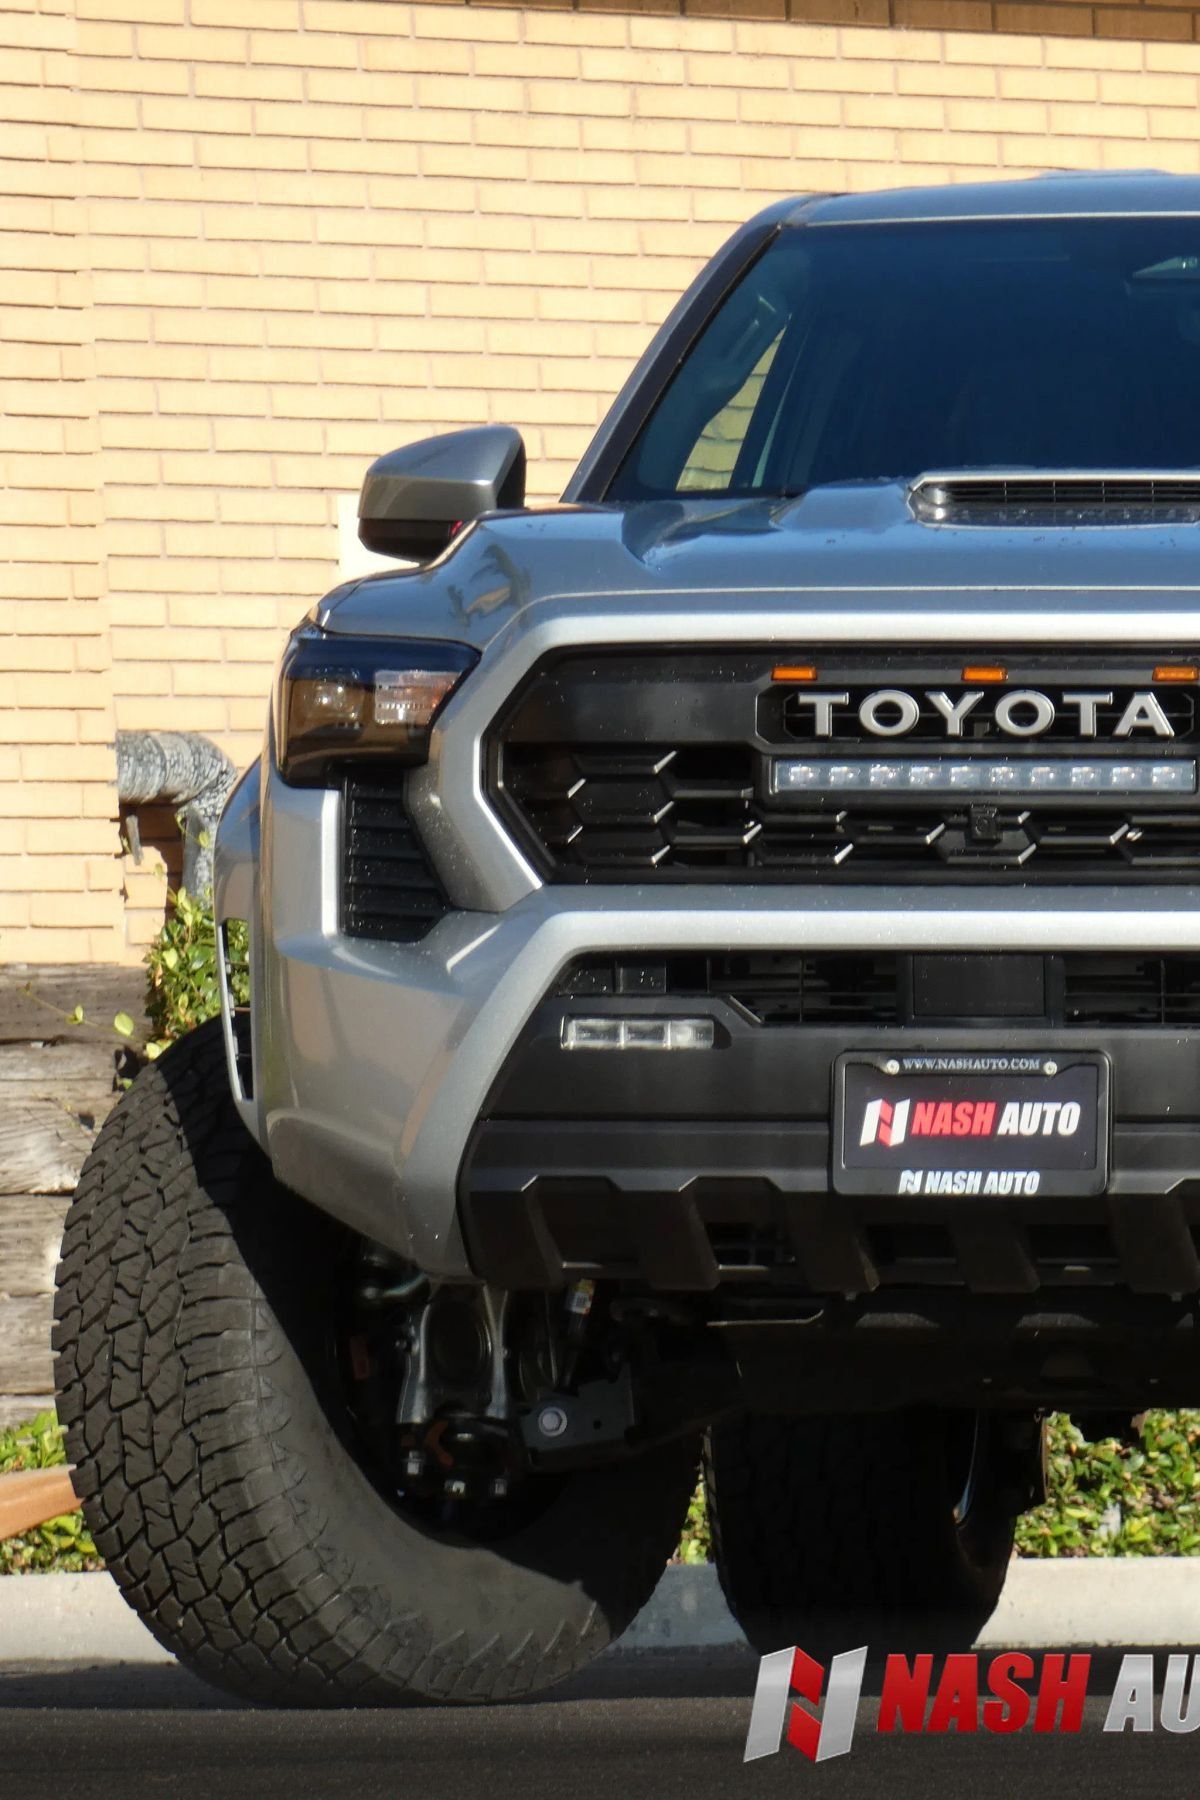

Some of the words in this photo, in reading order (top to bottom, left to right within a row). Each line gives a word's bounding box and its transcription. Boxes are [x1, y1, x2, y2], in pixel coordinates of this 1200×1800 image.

[798, 690, 1174, 737] TOYOTA
[902, 1058, 1040, 1071] WWW.NASHAUTO.COM
[911, 1101, 996, 1136] NASH
[997, 1101, 1081, 1136] AUTO
[924, 1170, 982, 1194] NASH
[983, 1170, 1041, 1194] AUTO
